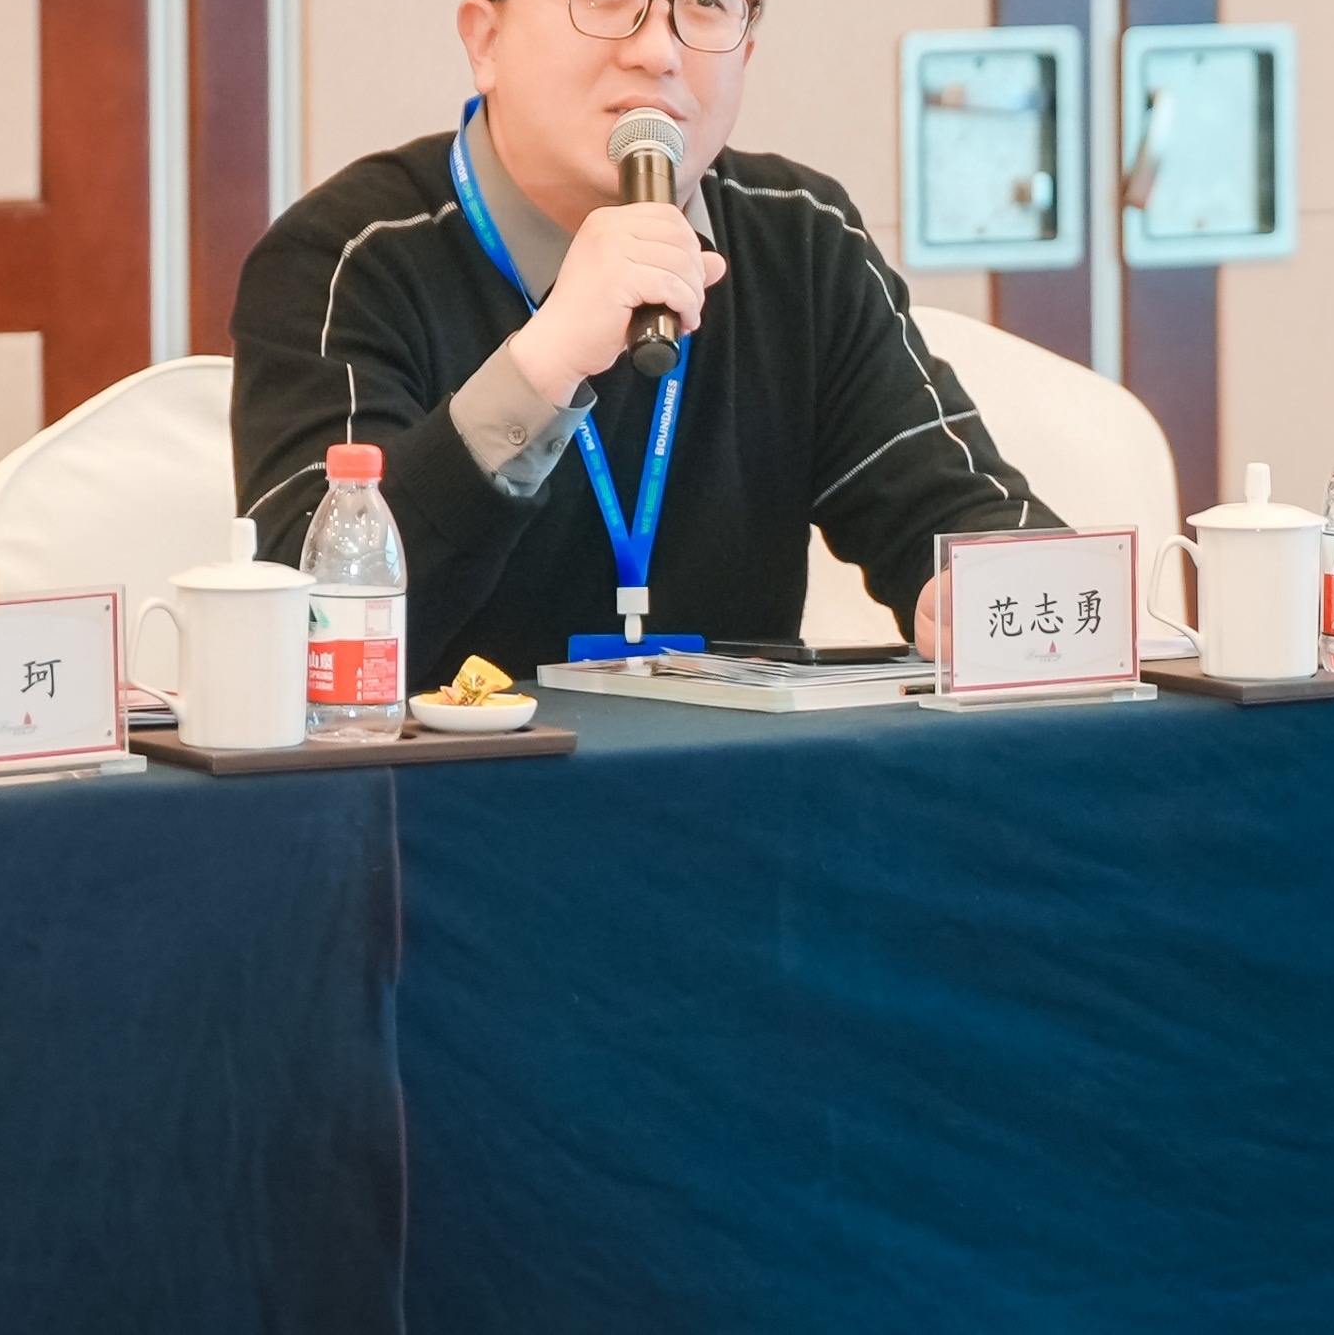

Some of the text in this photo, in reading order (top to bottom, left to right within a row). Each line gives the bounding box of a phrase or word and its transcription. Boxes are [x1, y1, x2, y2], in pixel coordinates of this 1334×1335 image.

[654, 378, 678, 456] BOUNDARIES
[988, 589, 1103, 638] 范志勇
